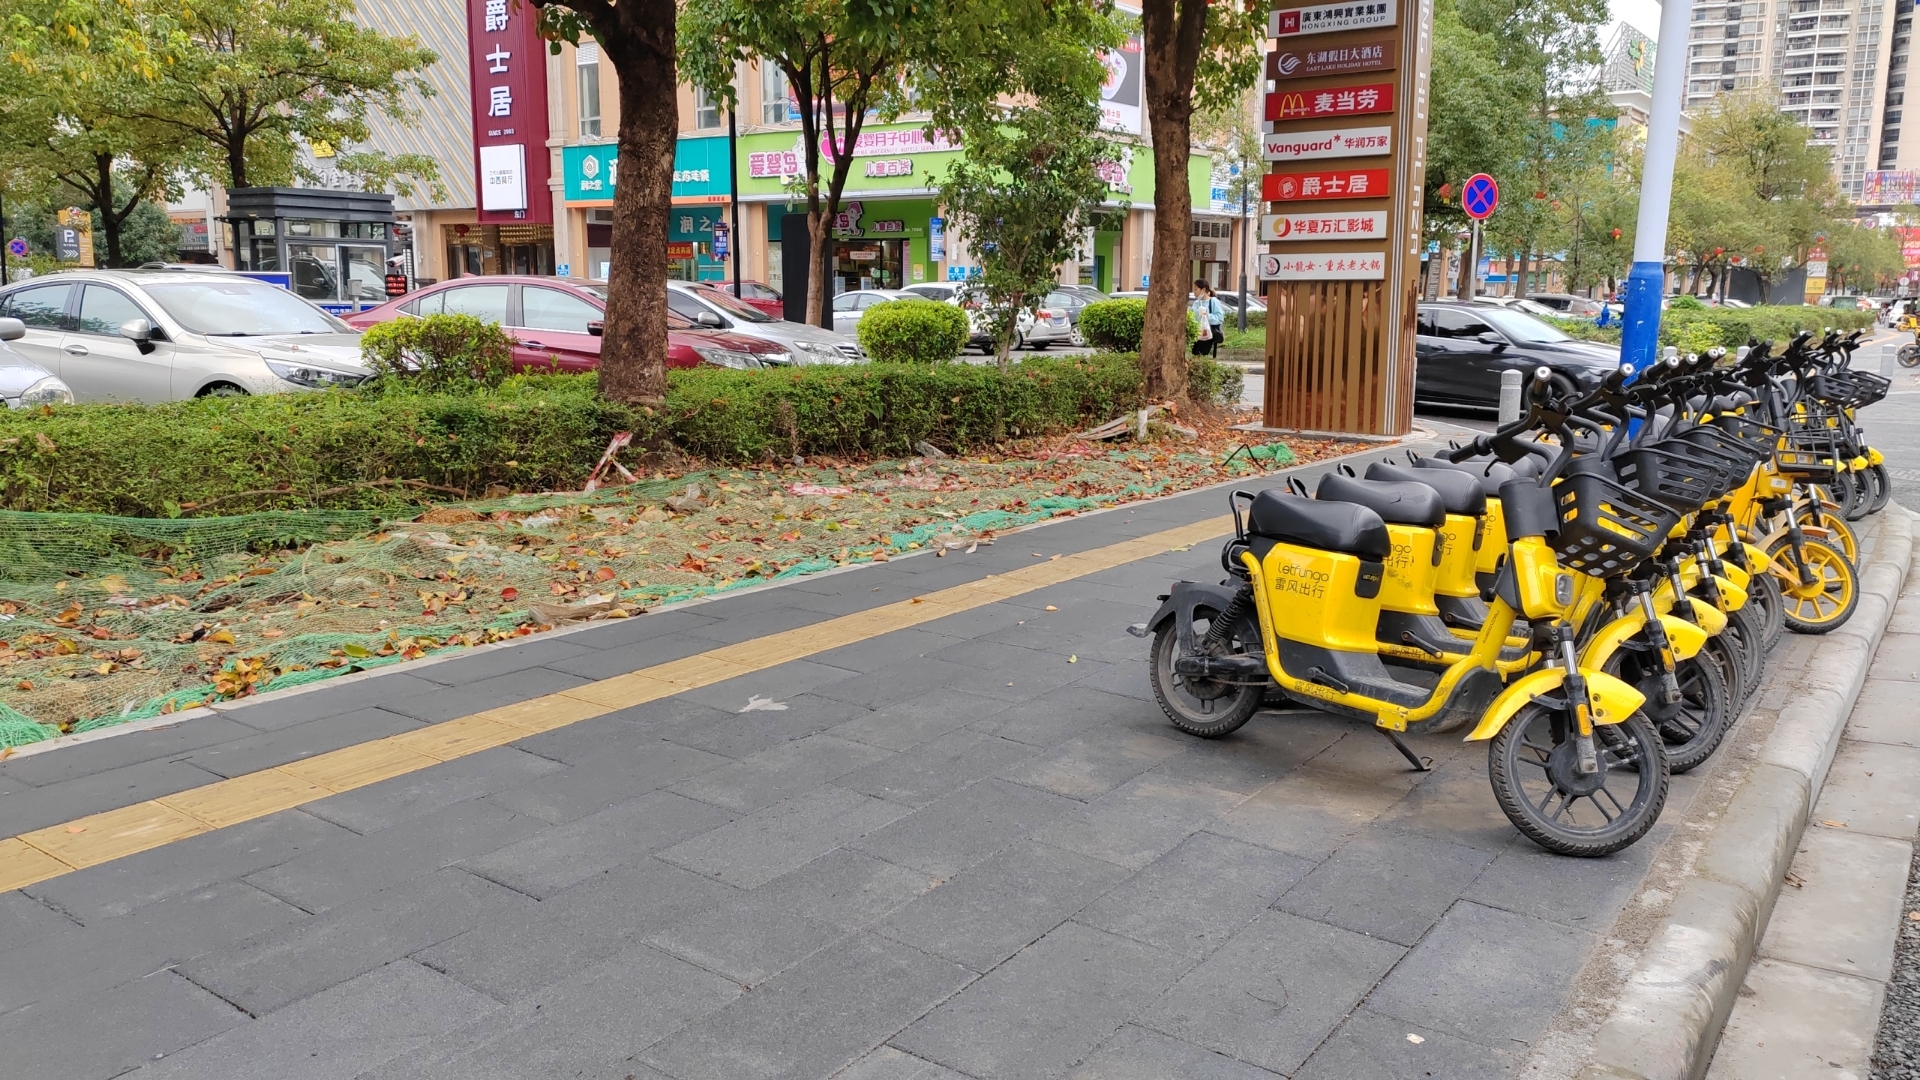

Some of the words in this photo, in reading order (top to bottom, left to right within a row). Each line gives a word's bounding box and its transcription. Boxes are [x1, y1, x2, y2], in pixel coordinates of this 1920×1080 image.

[1302, 3, 1387, 22] 廣東鴻興實業集團
[1302, 20, 1350, 30] HONGXING
[1353, 15, 1386, 25] GROUP
[485, 0, 512, 117] 爵士居
[1306, 46, 1383, 64] 东湖假日大酒店
[1337, 61, 1361, 69] HOLIDAY
[1314, 89, 1379, 113] 麦当劳
[488, 129, 502, 137] SINCE
[1344, 135, 1388, 149] 华润万家
[750, 152, 798, 176] 爱婴岛
[864, 159, 911, 177] 儿童百货
[1302, 174, 1369, 196] 爵士居
[1294, 217, 1374, 235] 华夏万汇影城
[1275, 577, 1325, 599] 雷风出行
